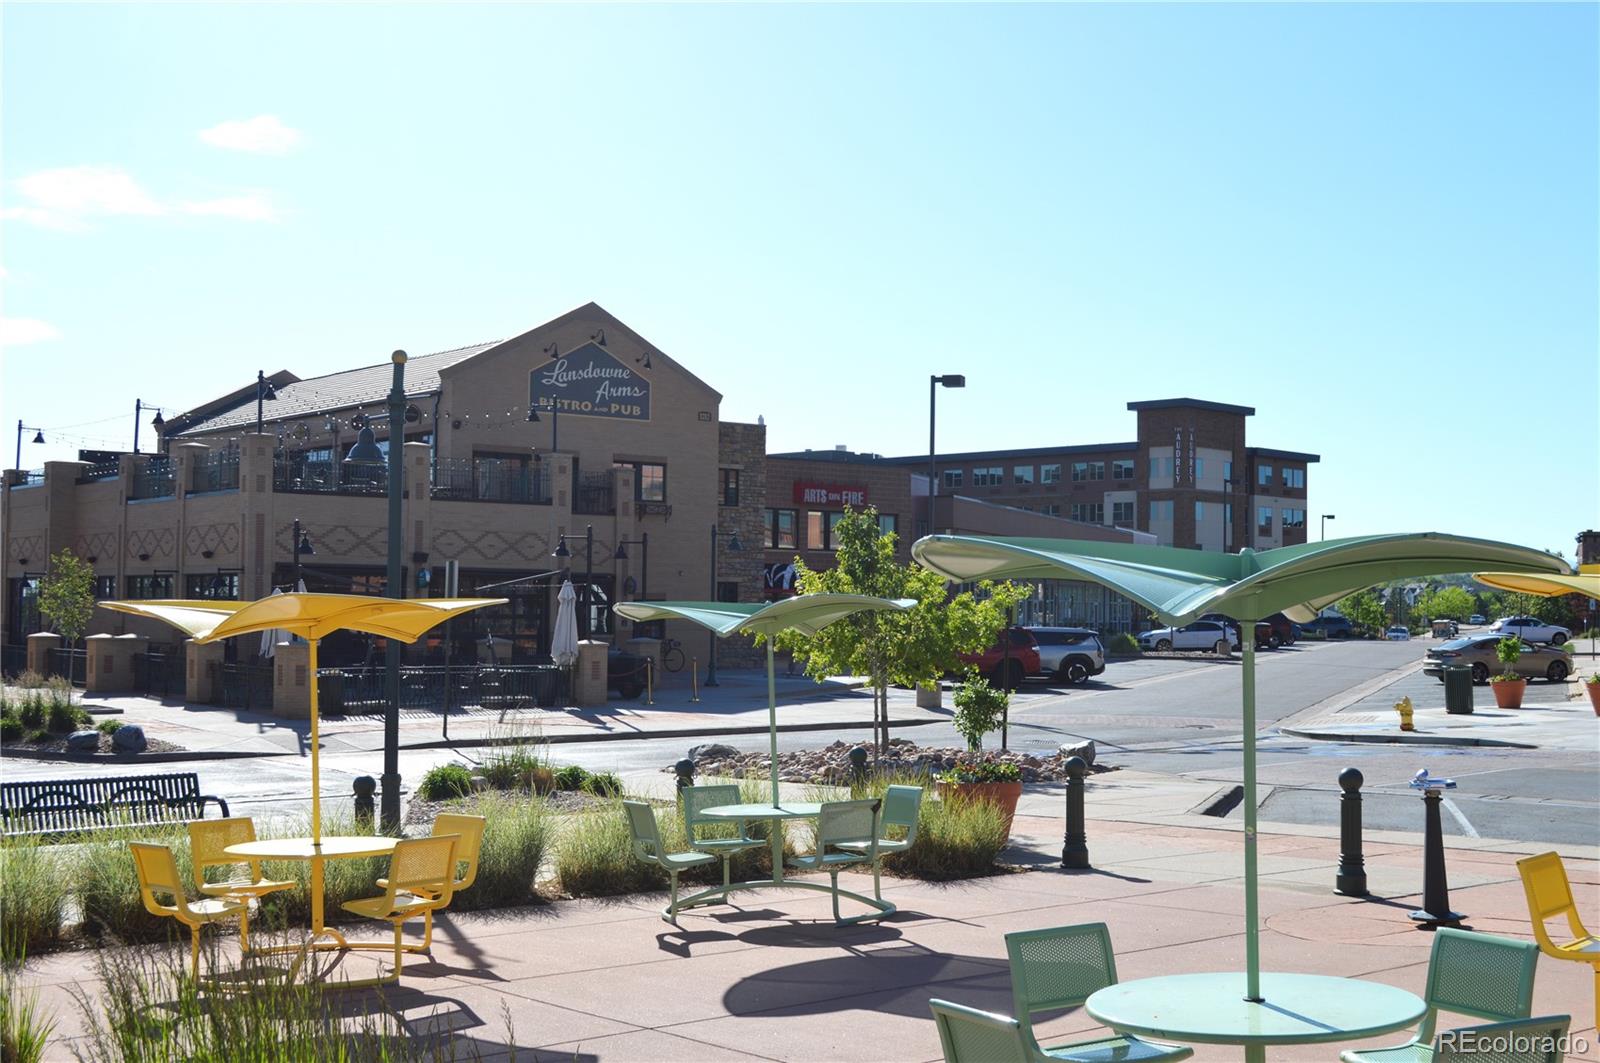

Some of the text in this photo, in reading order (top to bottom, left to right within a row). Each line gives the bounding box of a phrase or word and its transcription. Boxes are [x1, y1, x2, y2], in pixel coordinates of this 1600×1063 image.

[541, 359, 631, 387] Lansdowne
[595, 380, 647, 404] Arms
[611, 402, 641, 416] PUB
[803, 488, 828, 503] ARTS
[842, 490, 864, 505] FIRE
